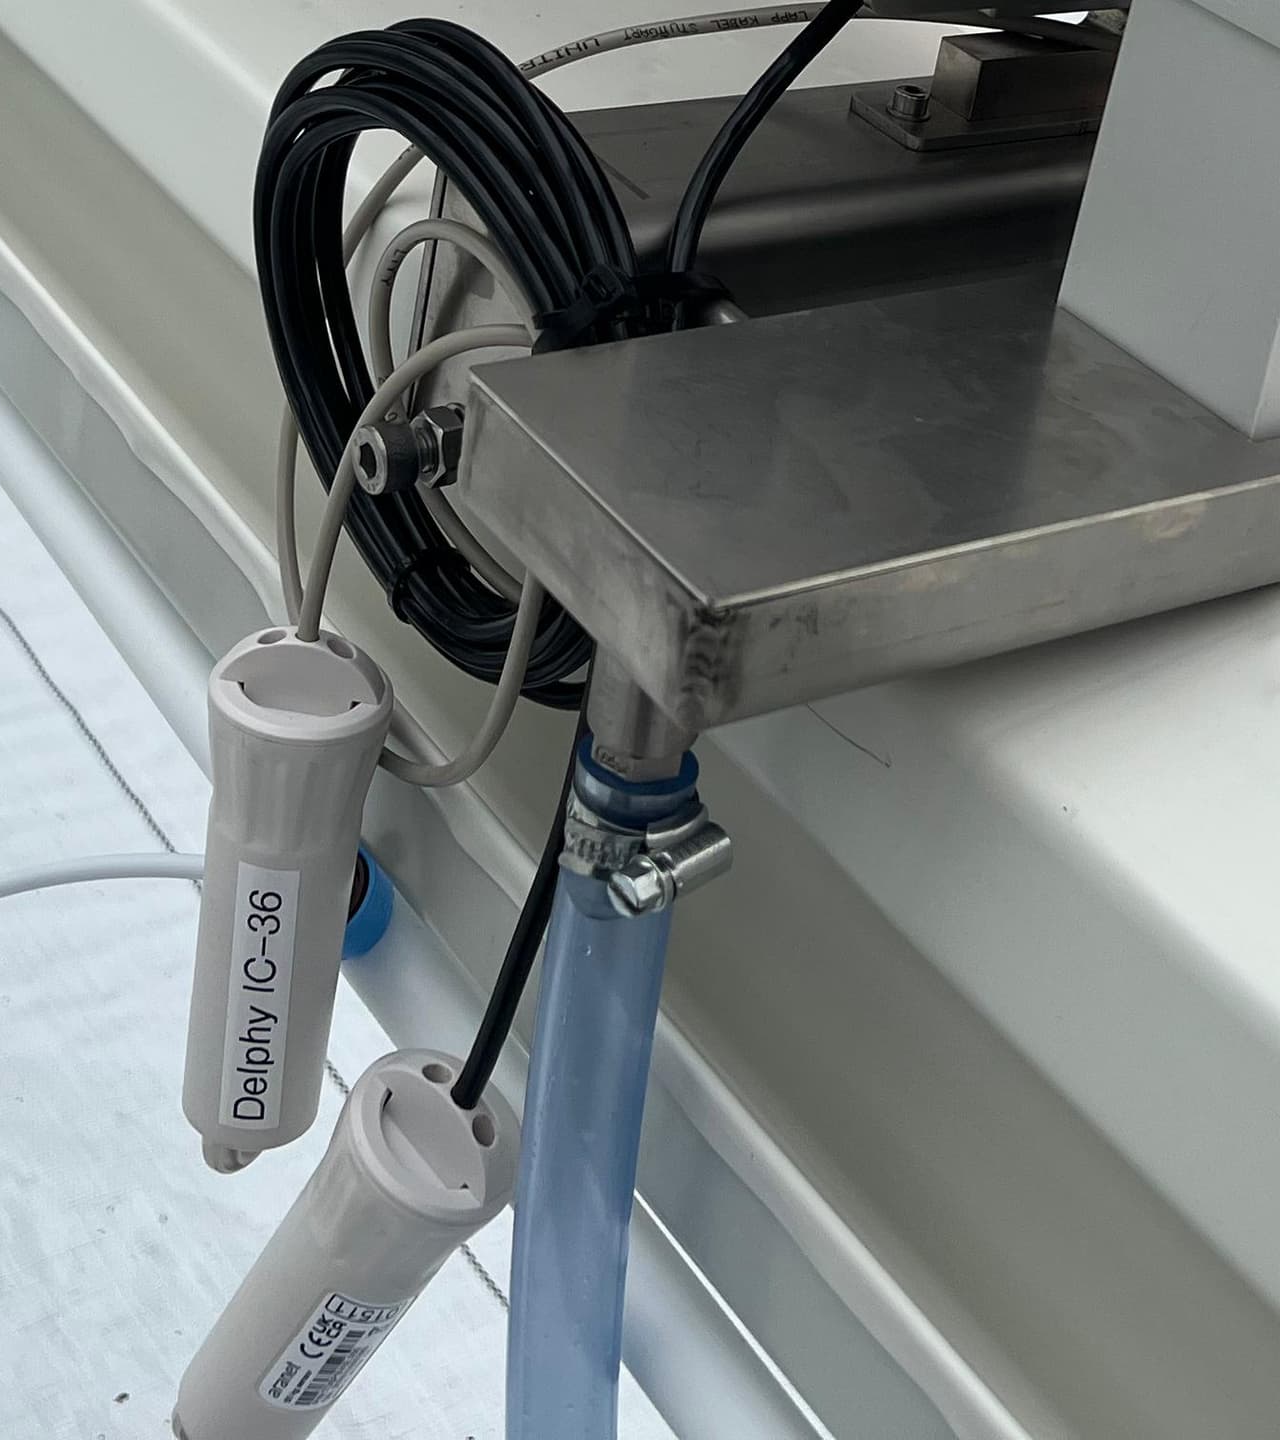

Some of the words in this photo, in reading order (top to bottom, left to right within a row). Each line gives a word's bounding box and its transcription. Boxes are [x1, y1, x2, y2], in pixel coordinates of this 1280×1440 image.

[711, 15, 759, 31] KABEL
[771, 10, 809, 24] LAPP
[242, 889, 282, 992] IC-36
[233, 1004, 278, 1120] Delphy
[268, 1361, 301, 1399] aranet
